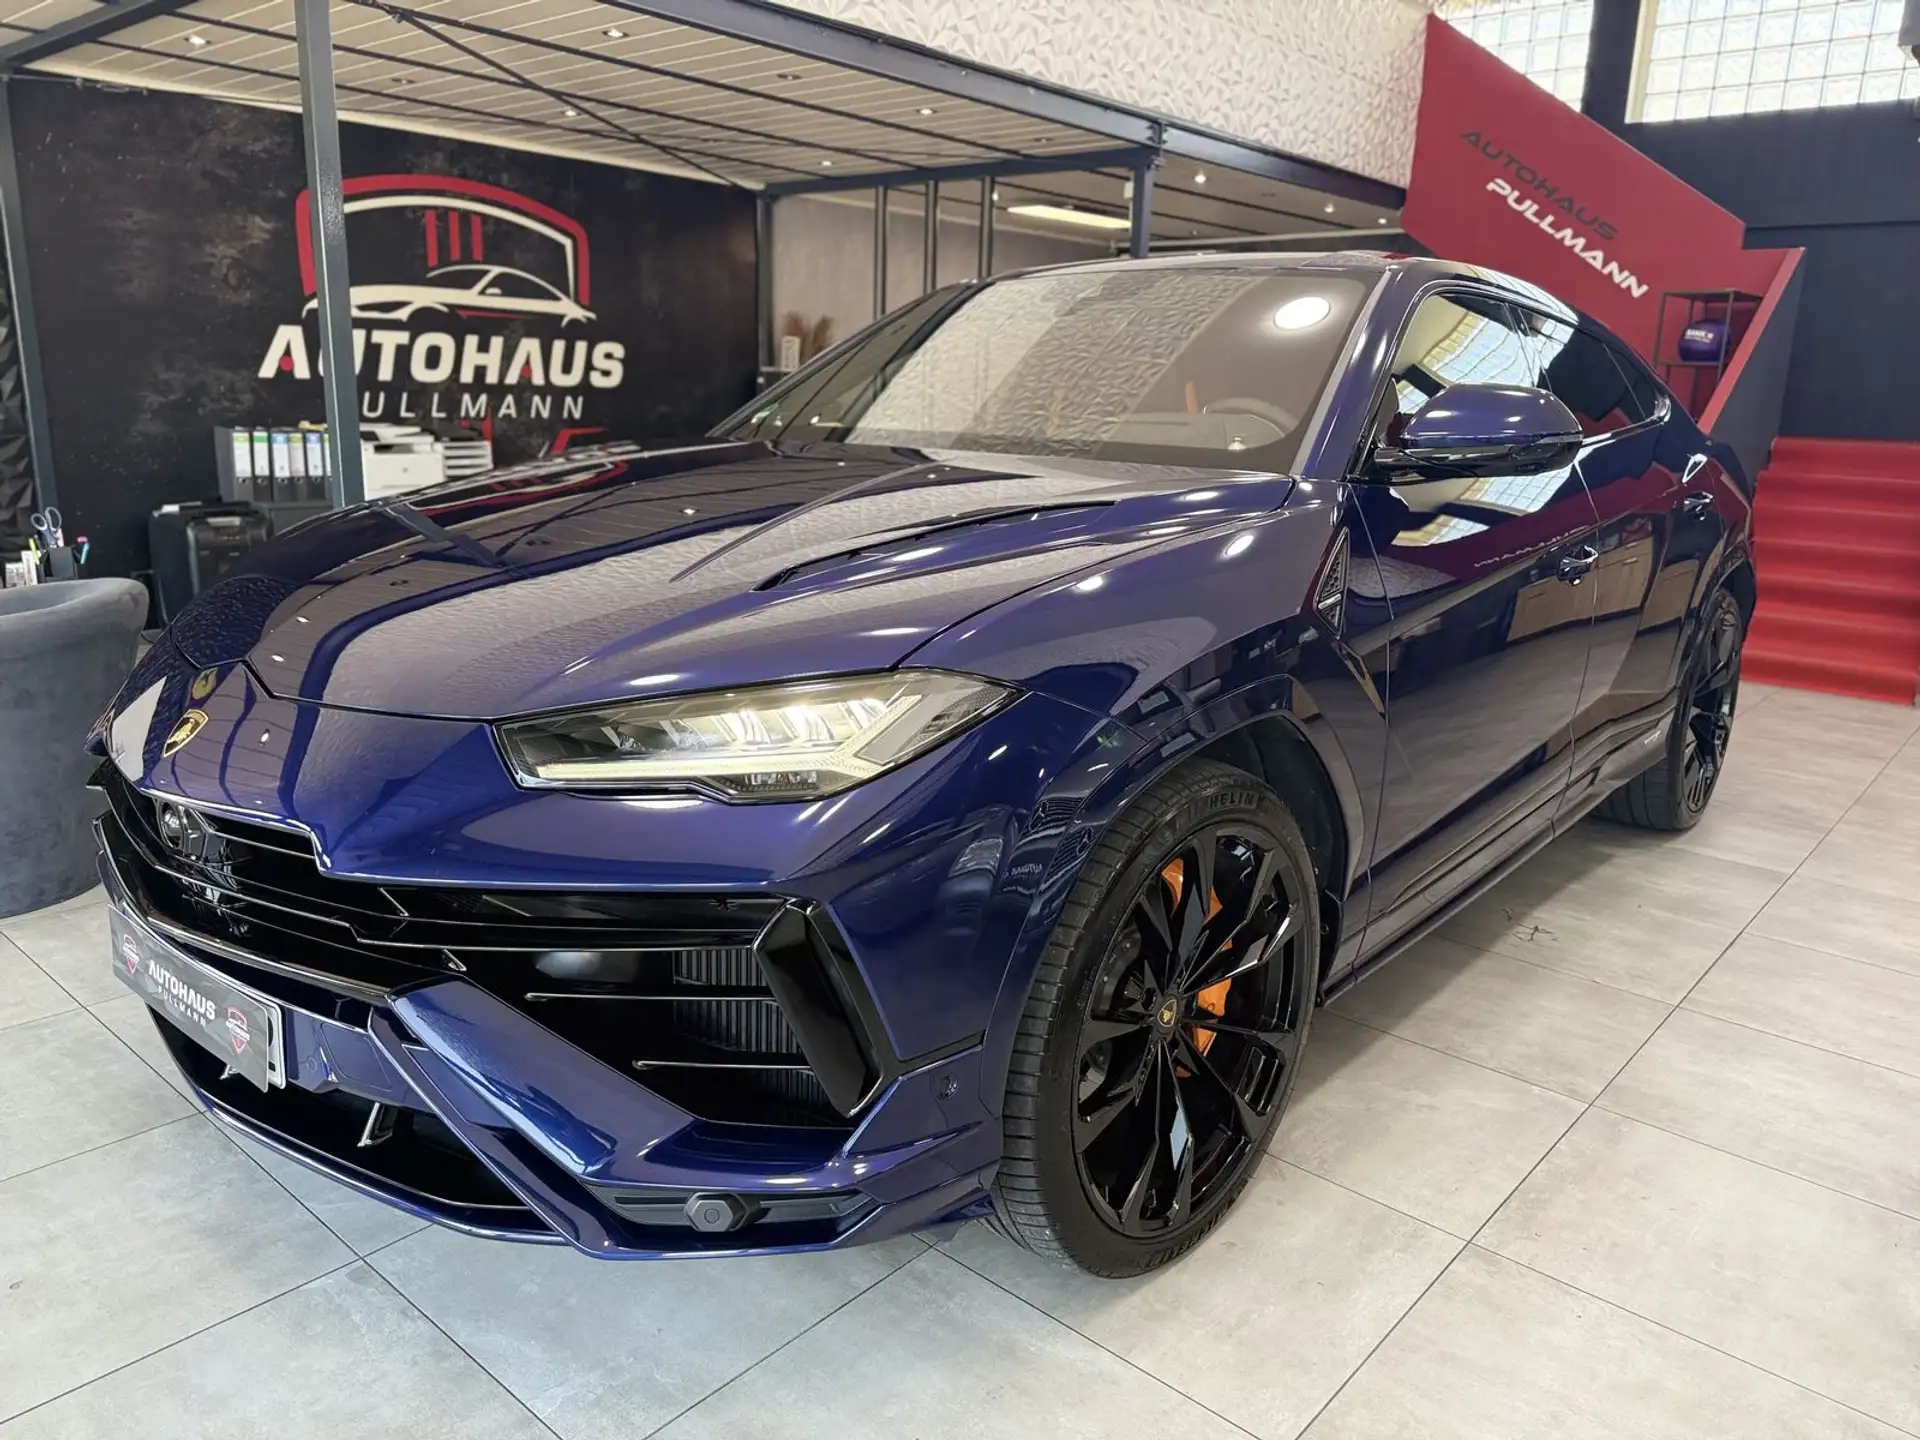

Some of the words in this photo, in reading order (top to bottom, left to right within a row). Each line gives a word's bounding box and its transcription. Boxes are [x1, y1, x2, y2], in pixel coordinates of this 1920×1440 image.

[1459, 131, 1619, 241] AUTOHAUS
[1486, 178, 1649, 298] PULLMANN
[362, 391, 584, 420] ULLMANN
[149, 960, 215, 1020] AUTOHAUS
[158, 985, 207, 1028] PULLMANN
